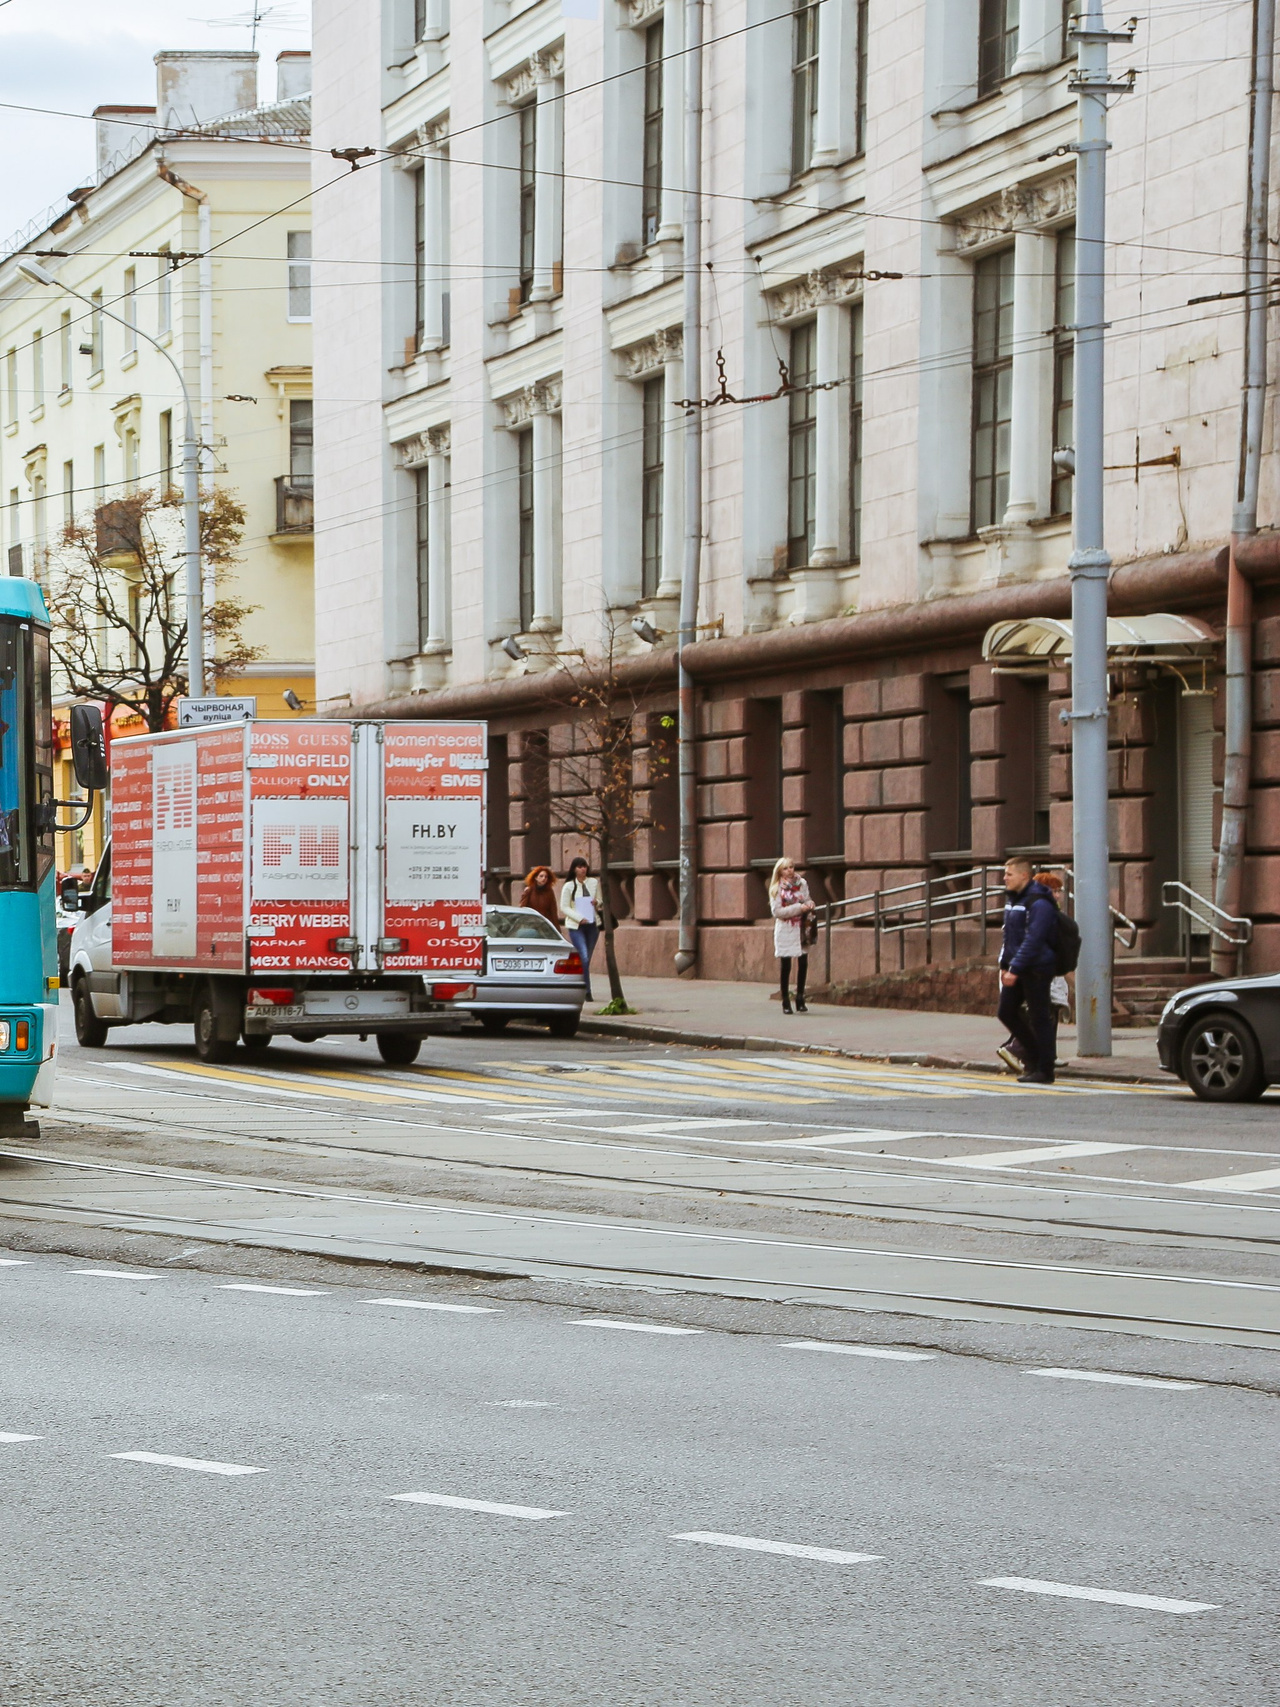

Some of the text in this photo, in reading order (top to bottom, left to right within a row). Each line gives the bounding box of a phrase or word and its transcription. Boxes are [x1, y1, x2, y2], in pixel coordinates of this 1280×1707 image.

[191, 703, 244, 713] ЧЫРВОНАЯ
[203, 713, 232, 722] вуліца
[251, 733, 349, 747] BOSS GUESS
[385, 734, 482, 747] women'secret
[386, 753, 445, 772] Jennyfer
[251, 776, 304, 786] CALLIOPE
[441, 774, 481, 787] SMS
[412, 824, 457, 838] FH.BY
[262, 872, 339, 880] FASHION HOUSE
[250, 914, 350, 928] GERRY WEBER
[427, 937, 483, 953] orsay
[296, 957, 350, 967] MANGO
[431, 957, 483, 967] TAIFUN
